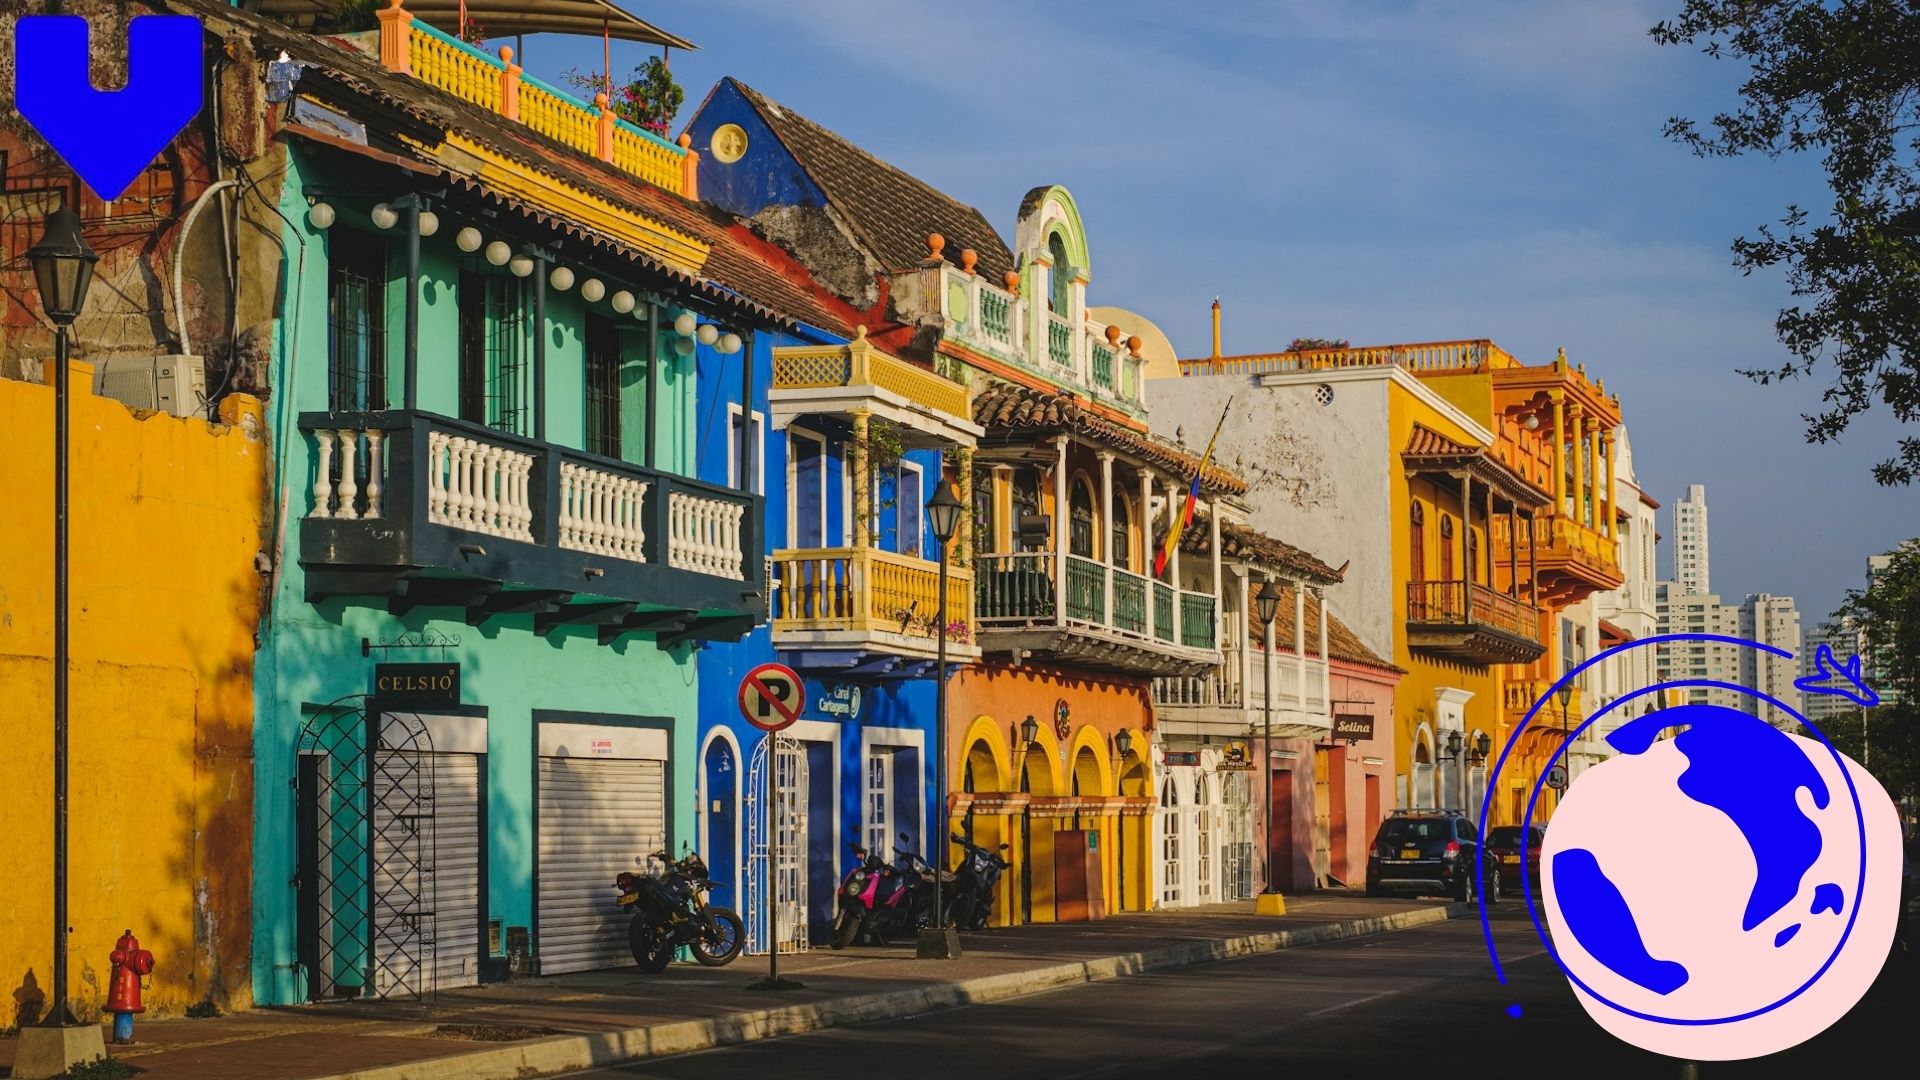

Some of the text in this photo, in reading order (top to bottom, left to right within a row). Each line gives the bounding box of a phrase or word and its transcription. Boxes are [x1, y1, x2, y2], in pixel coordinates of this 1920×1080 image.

[833, 685, 850, 700] Canal
[819, 698, 850, 716] Cartagena
[1337, 720, 1370, 733] Selina
